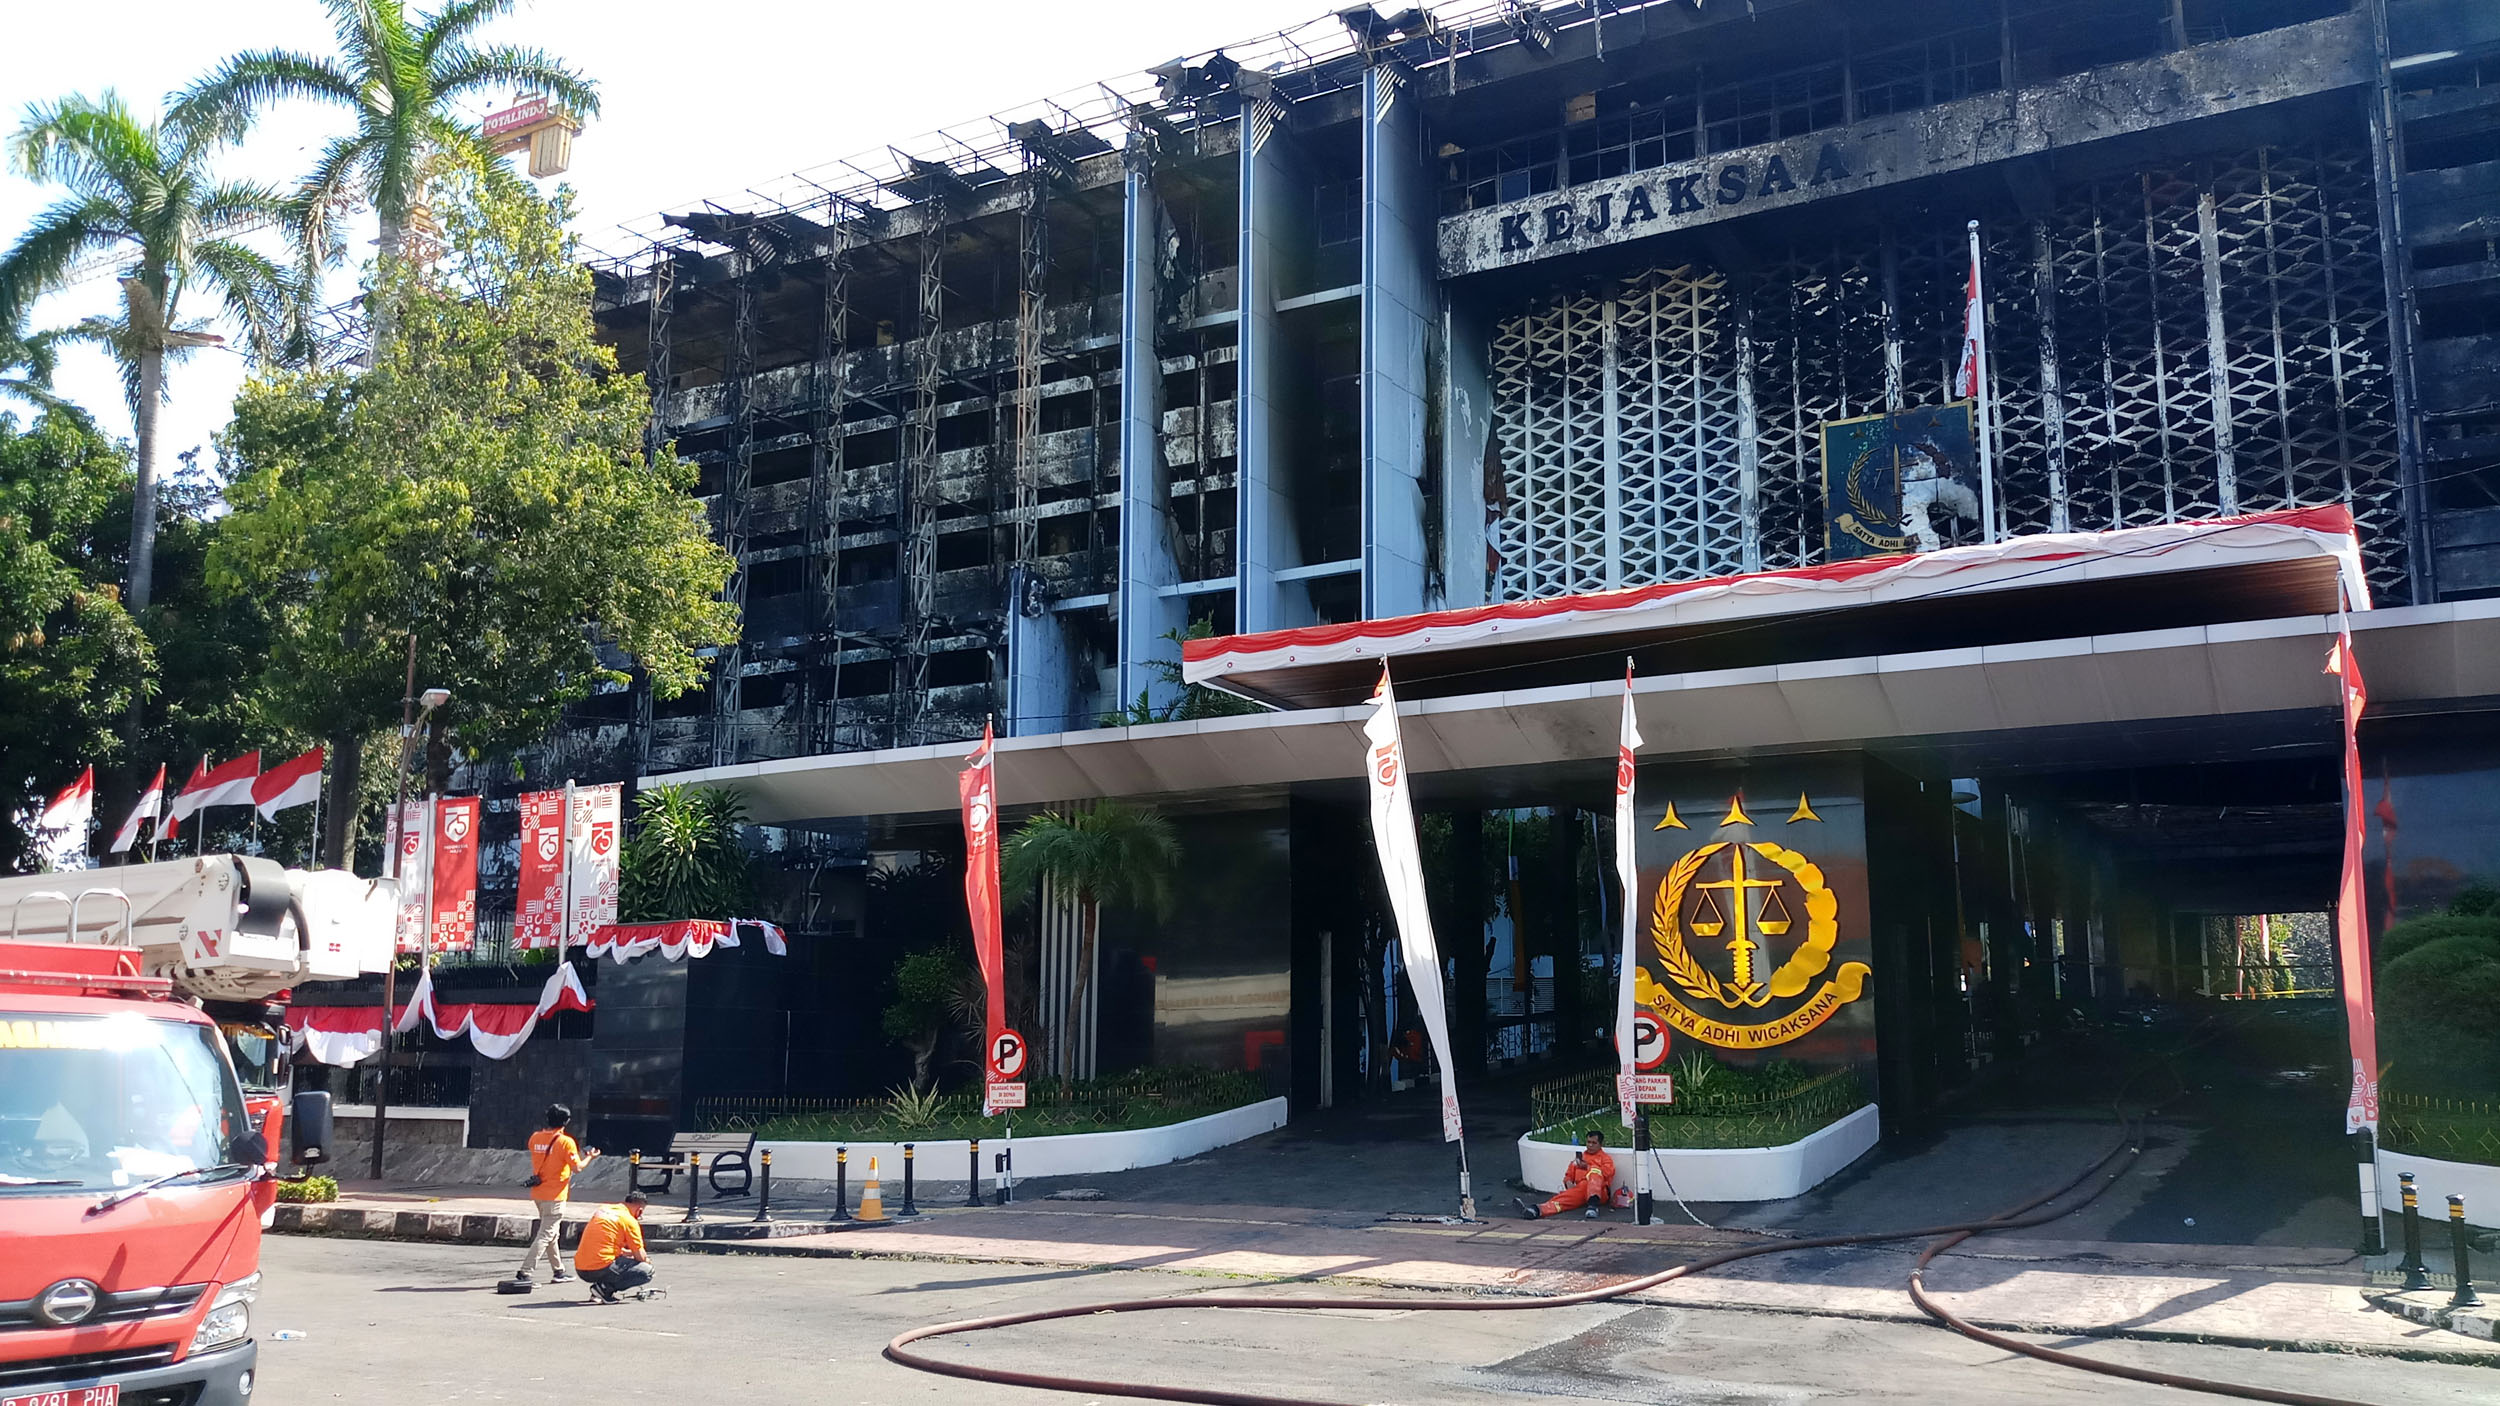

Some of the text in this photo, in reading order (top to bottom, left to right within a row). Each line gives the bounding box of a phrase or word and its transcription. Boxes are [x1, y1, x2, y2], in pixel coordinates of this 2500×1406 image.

[484, 103, 545, 130] TOTALINDO
[1853, 526, 1875, 544] SATYA
[1653, 992, 1838, 1043] SATYA ADHI WICAKSANA
[1000, 1039, 1017, 1069] P
[1635, 1023, 1657, 1058] P
